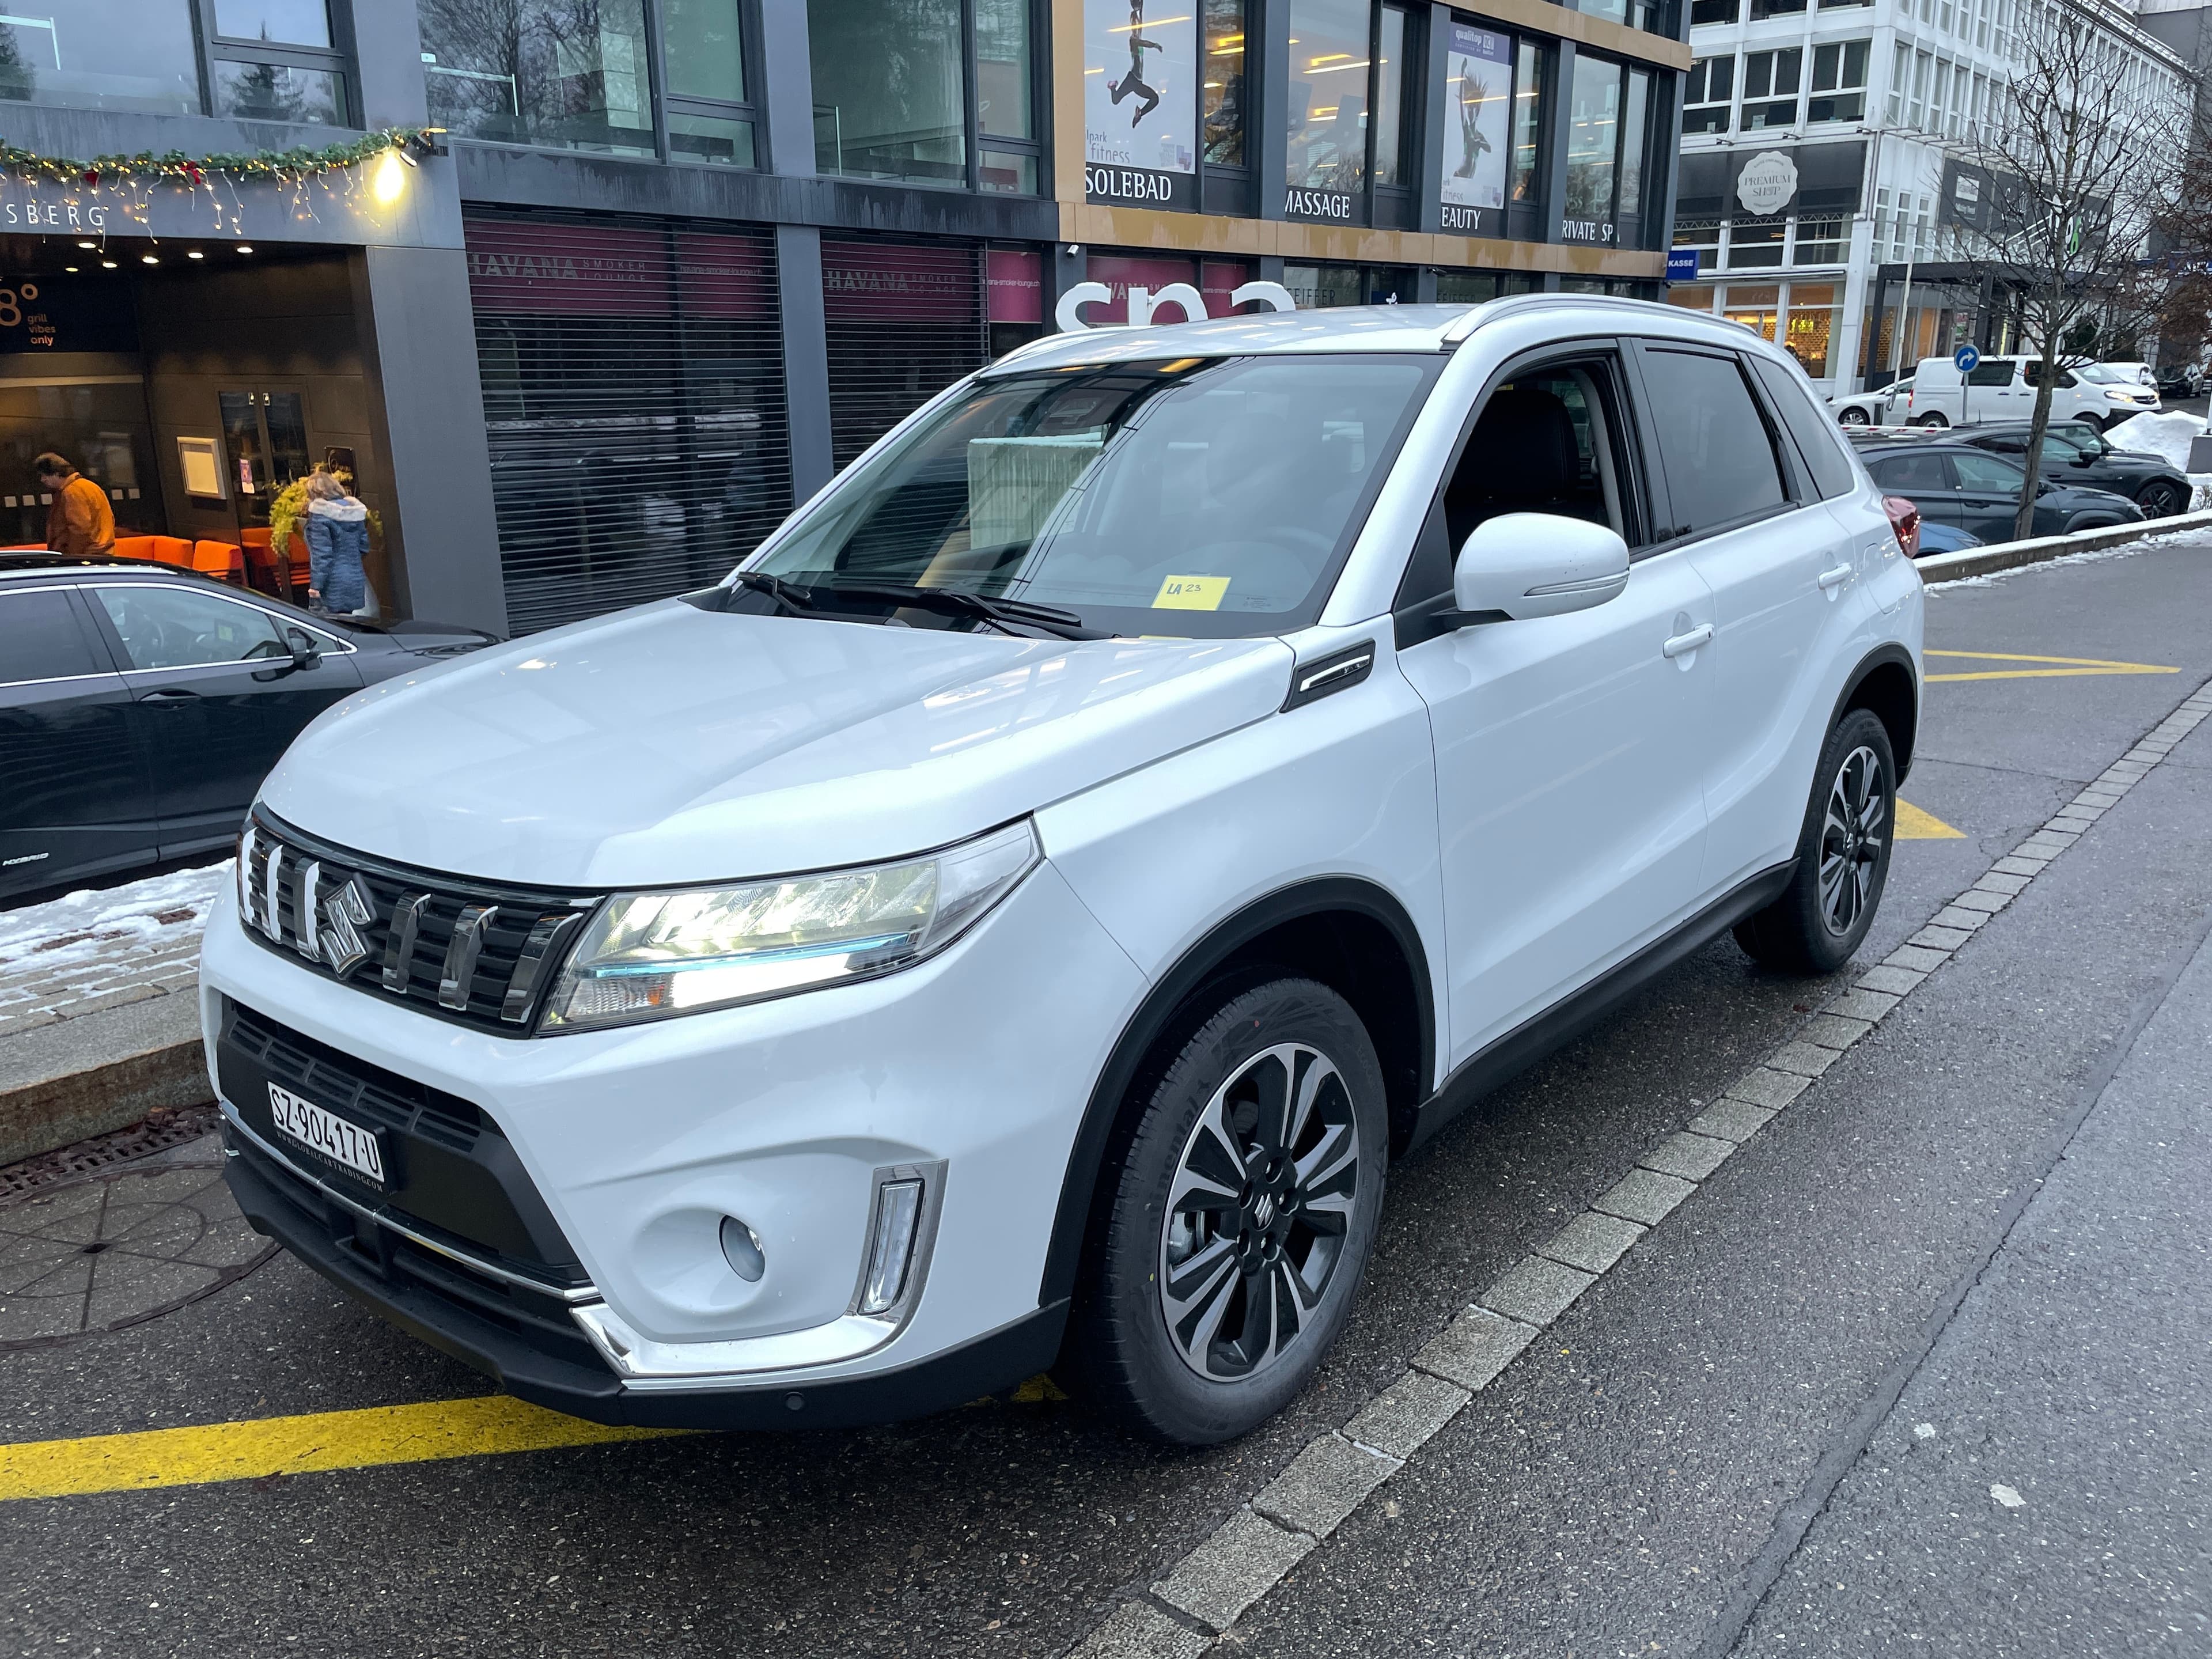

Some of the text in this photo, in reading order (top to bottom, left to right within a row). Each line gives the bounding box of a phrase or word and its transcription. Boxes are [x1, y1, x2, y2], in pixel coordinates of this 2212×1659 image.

[1456, 29, 1482, 46] qualitop
[1091, 143, 1130, 164] fitness
[1085, 167, 1172, 201] SOLEBAD
[1744, 175, 1790, 185] PREMIUM
[1601, 224, 1620, 243] SP
[583, 259, 645, 270] SMOKER
[827, 270, 910, 293] HAVANA
[912, 274, 957, 283] SMOKER
[1287, 288, 1336, 305] EIFFER
[28, 313, 47, 325] grill
[29, 325, 56, 333] vibes
[31, 335, 54, 346] only
[1166, 584, 1182, 594] LA
